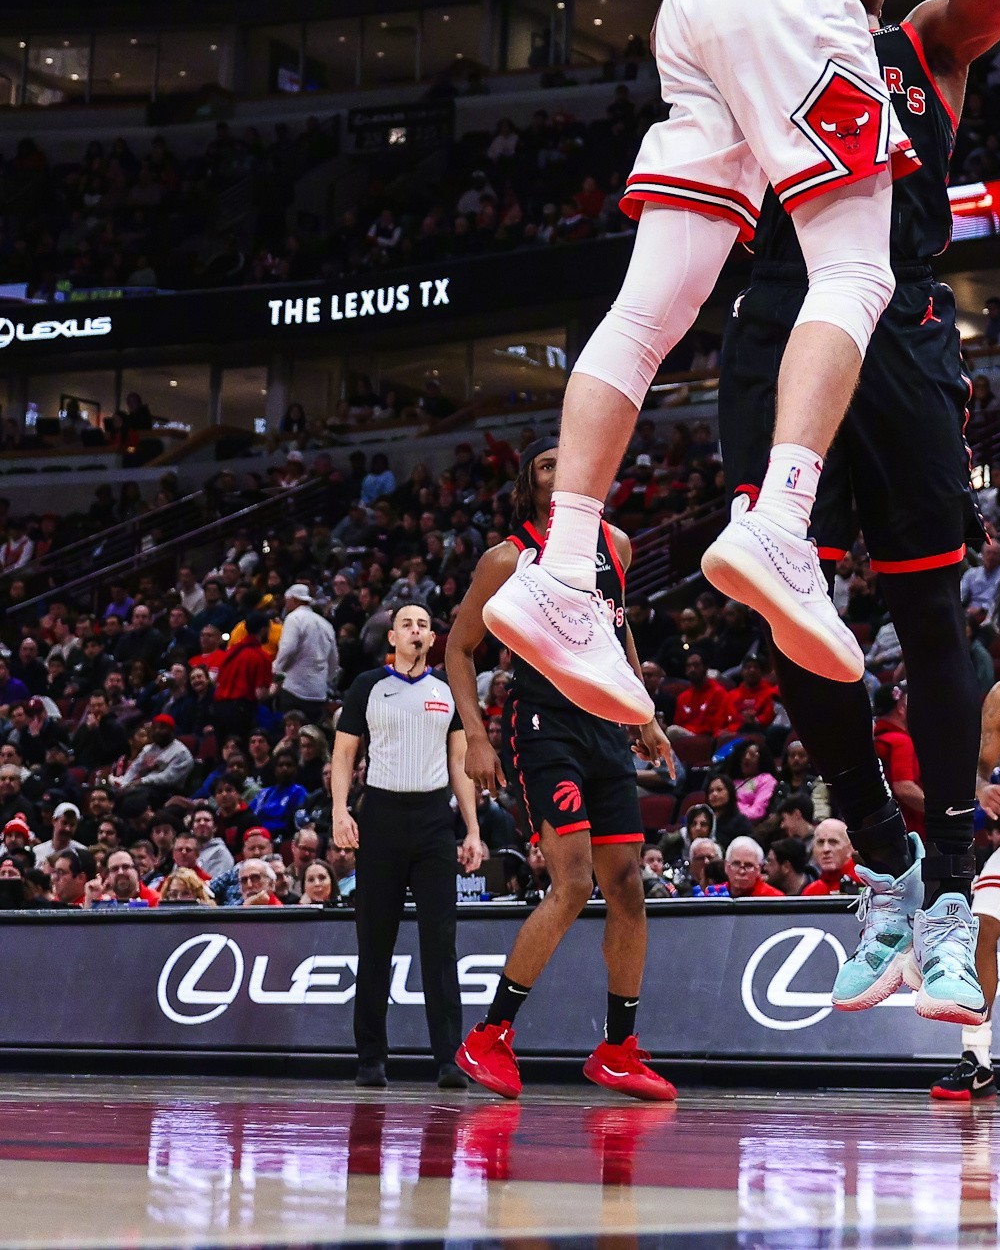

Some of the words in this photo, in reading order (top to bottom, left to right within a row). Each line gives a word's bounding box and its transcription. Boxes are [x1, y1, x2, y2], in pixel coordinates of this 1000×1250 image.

[268, 297, 322, 326] THE
[330, 284, 410, 321] LEXUS
[419, 277, 450, 308] TX
[16, 316, 112, 342] LEXUS
